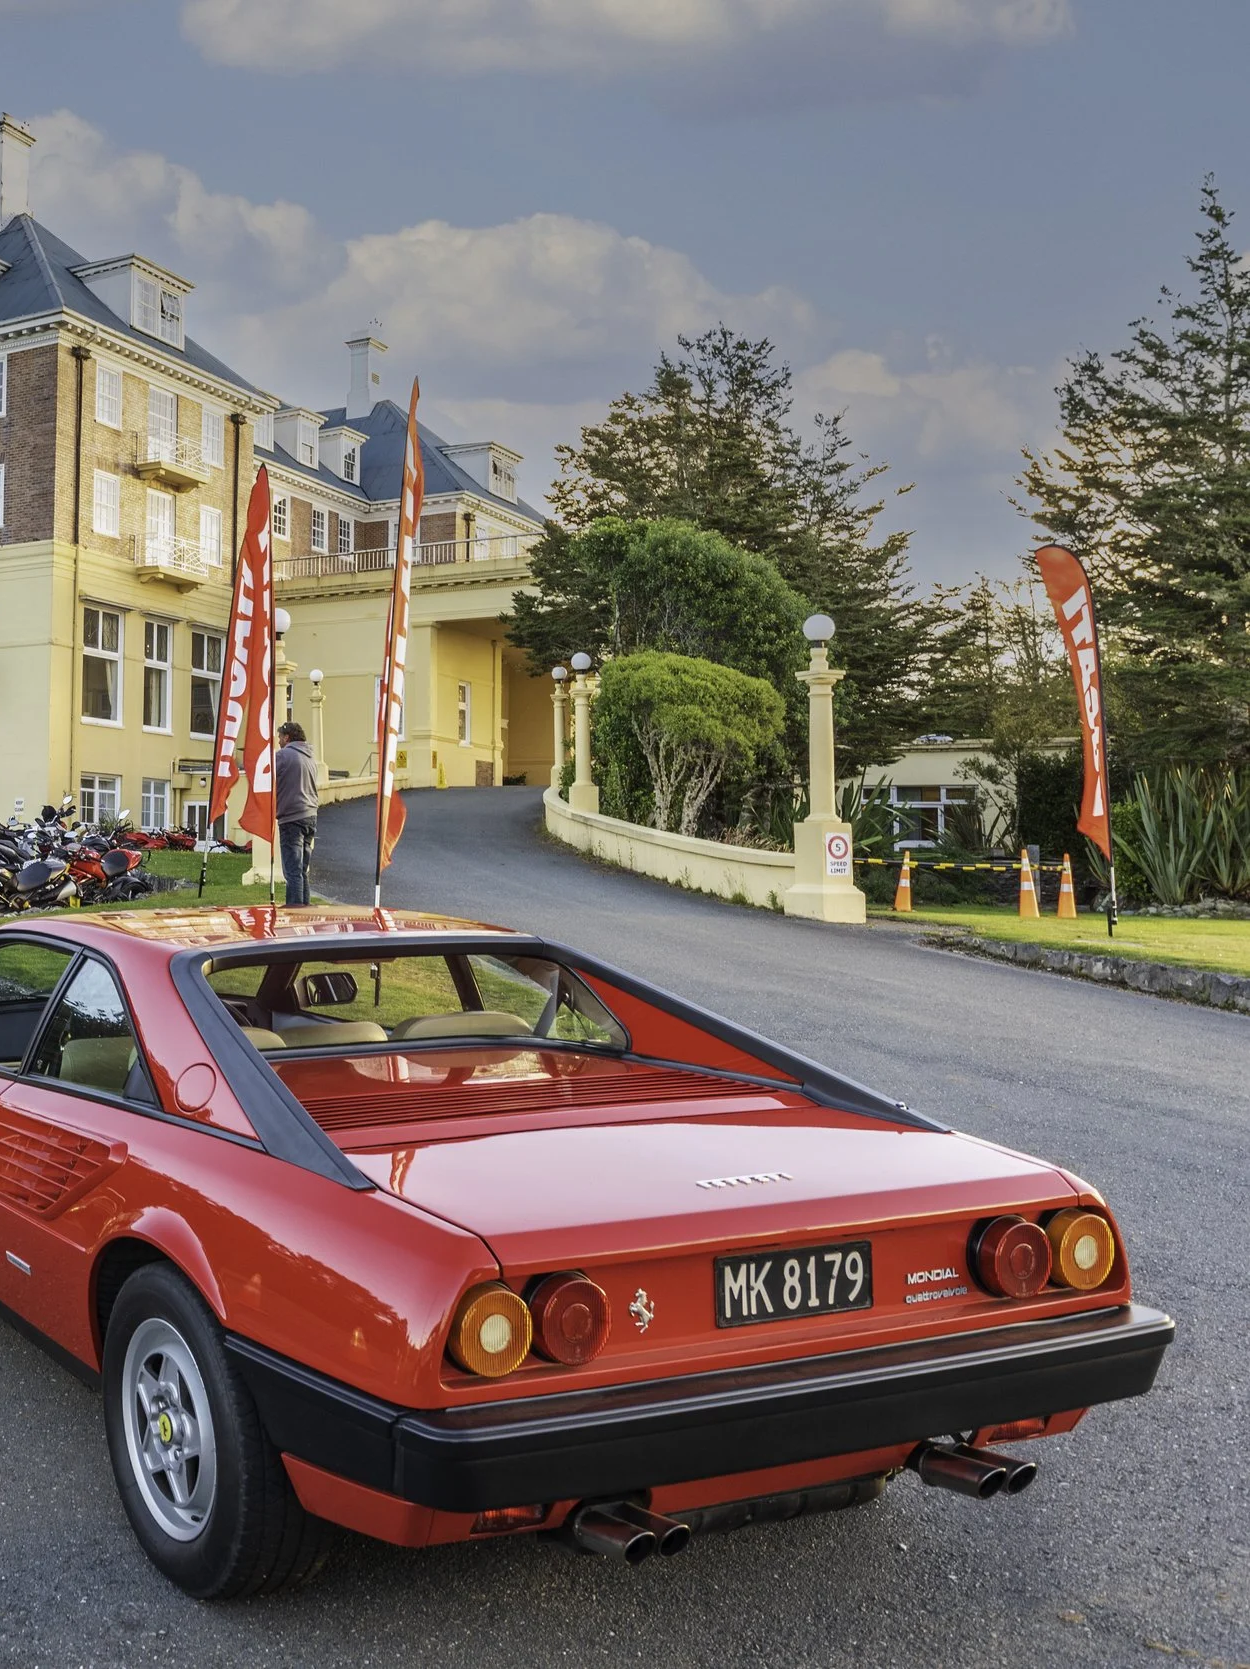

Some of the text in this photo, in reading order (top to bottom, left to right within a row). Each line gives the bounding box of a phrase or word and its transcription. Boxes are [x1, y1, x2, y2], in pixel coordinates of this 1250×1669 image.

[835, 843, 841, 852] 5
[724, 1251, 864, 1319] MK 8179
[907, 1266, 959, 1285] MONDIAL
